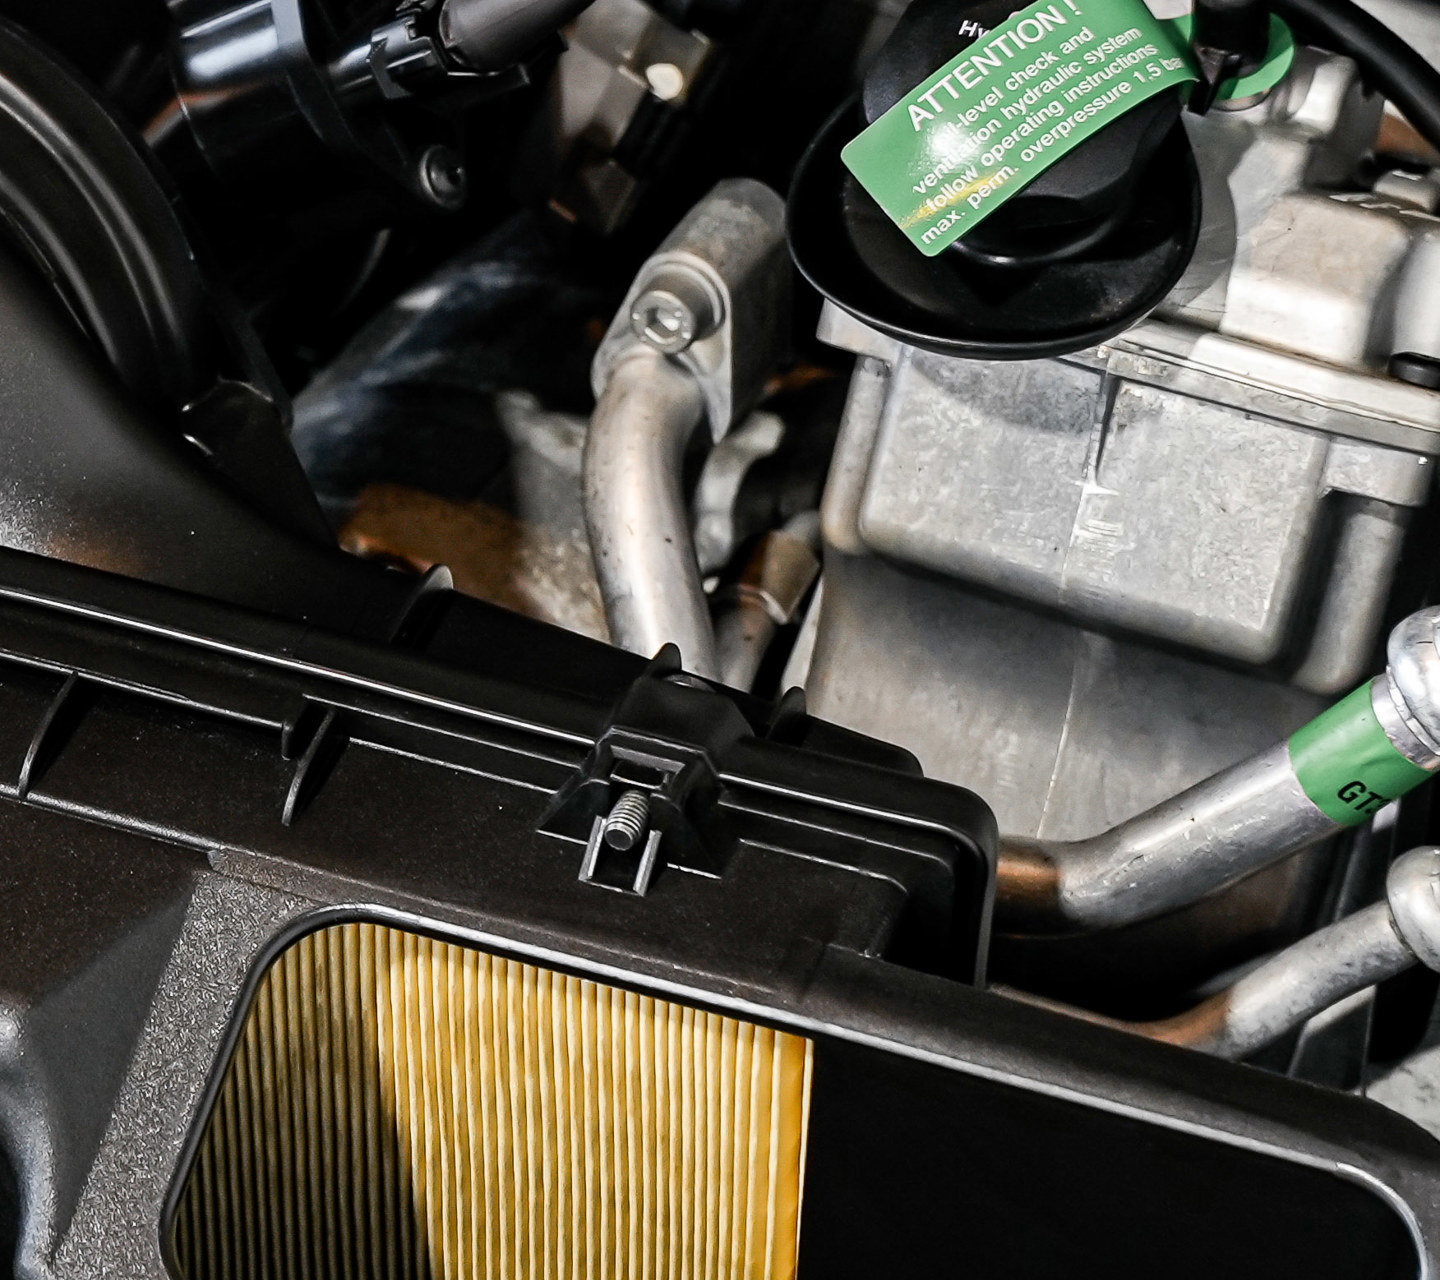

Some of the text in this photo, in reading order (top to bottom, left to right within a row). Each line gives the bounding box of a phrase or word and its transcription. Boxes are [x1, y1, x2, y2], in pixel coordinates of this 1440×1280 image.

[907, 4, 1068, 132] ATTENTION
[1000, 60, 1082, 122] hydraulic
[1084, 27, 1143, 65] system
[1005, 50, 1060, 91] check
[1058, 26, 1095, 55] and
[920, 209, 966, 245] max.
[966, 165, 1020, 210] perm.
[1020, 79, 1133, 163] overpressure
[1132, 63, 1163, 85] 1.5
[925, 43, 1159, 213] follow operating instructions
